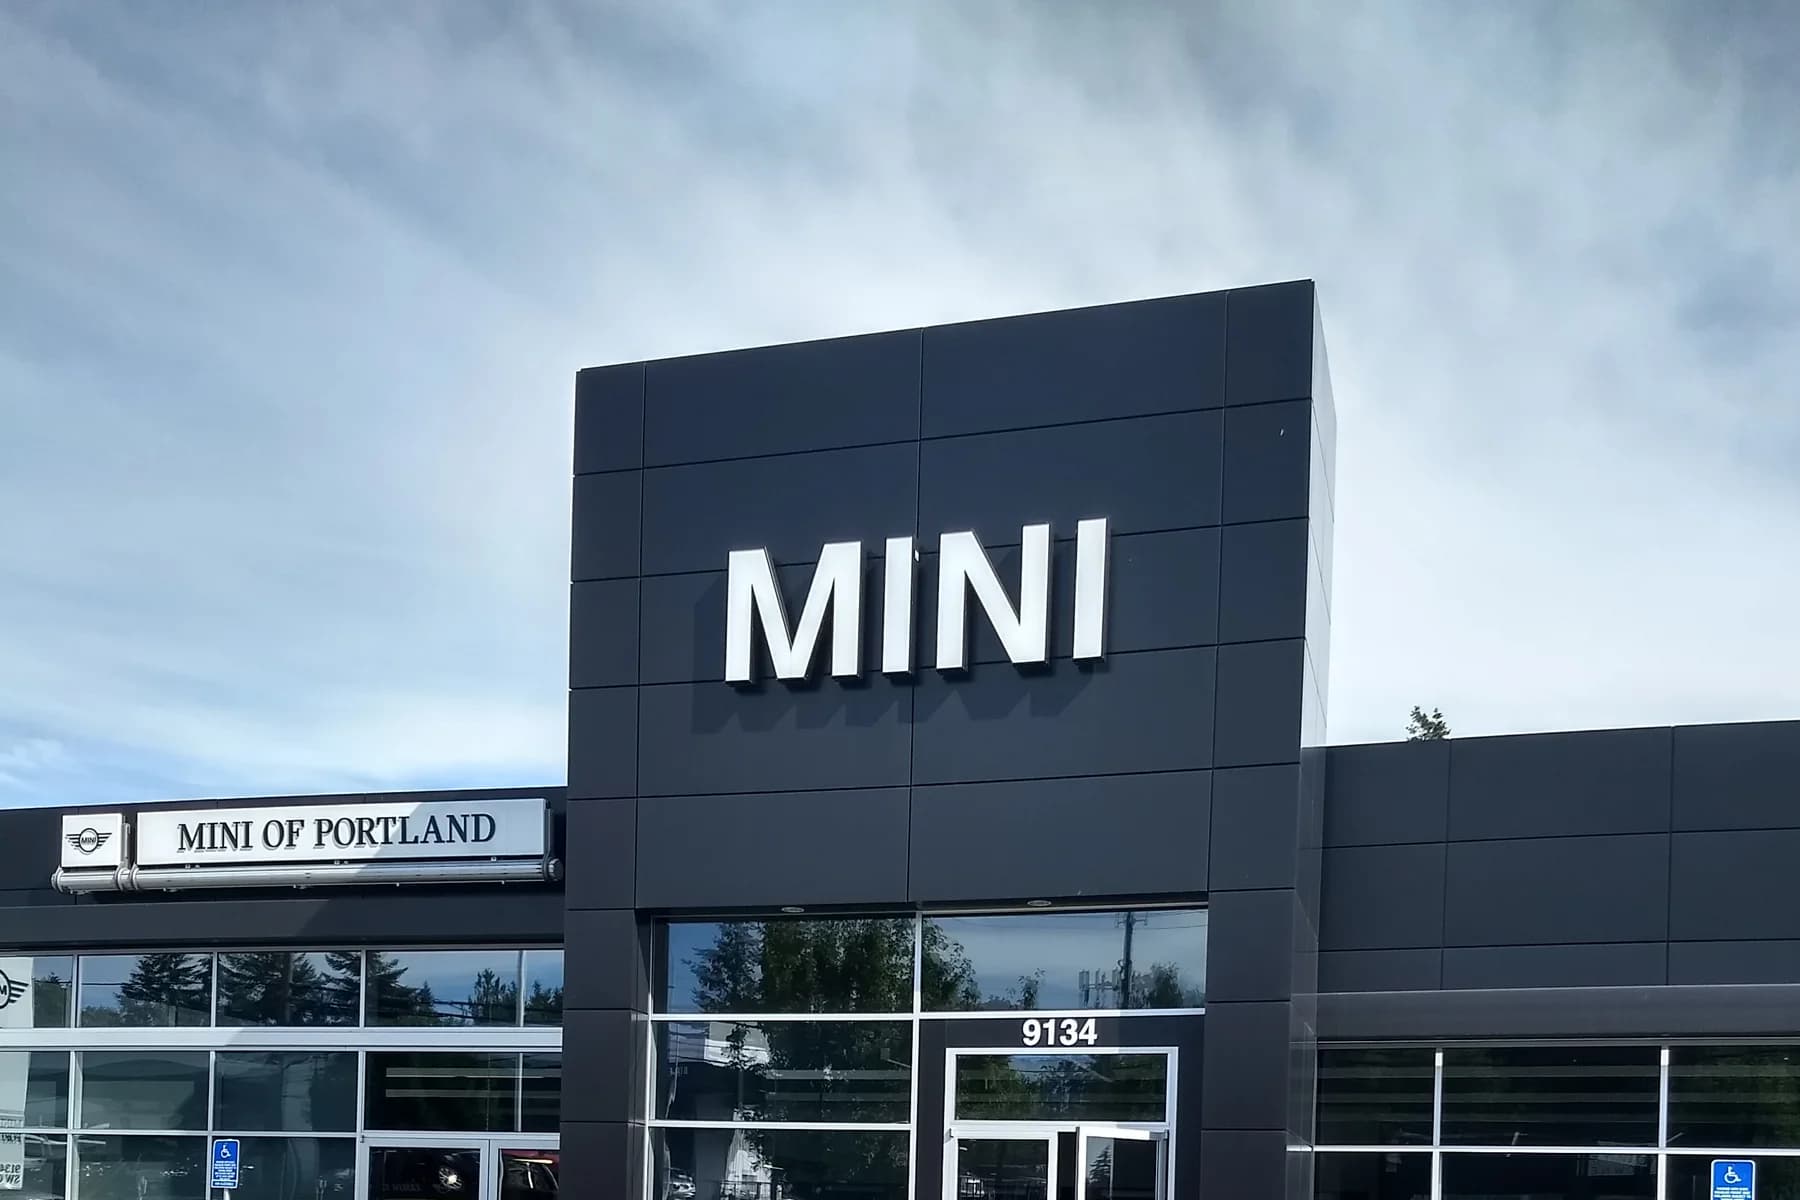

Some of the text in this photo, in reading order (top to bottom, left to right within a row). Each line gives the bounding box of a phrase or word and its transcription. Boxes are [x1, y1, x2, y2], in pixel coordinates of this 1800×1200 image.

[725, 517, 1109, 685] MINI
[178, 814, 496, 851] MINI OF PORTLAND
[1022, 1018, 1098, 1046] 9134
